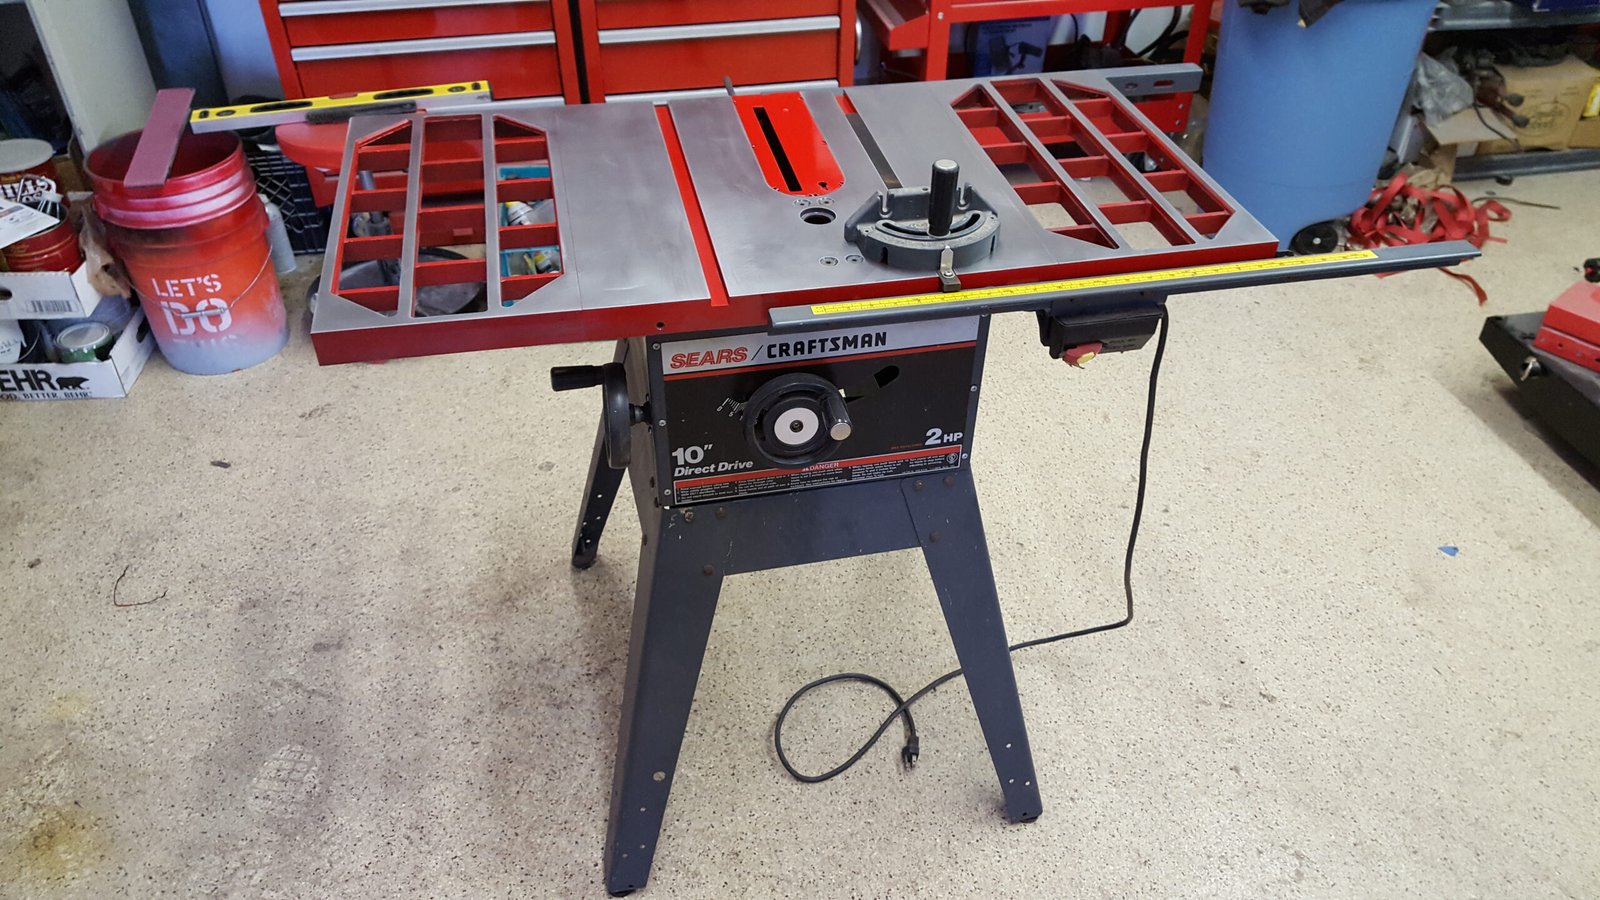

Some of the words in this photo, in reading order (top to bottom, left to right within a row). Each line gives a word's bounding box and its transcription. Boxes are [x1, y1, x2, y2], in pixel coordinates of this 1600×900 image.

[152, 273, 222, 297] LET'S
[160, 298, 232, 336] DO
[670, 347, 748, 369] SEARS
[767, 332, 887, 359] CRAFTSMAN
[0, 369, 58, 391] EHR
[925, 428, 943, 446] 2
[943, 432, 963, 443] HP
[674, 464, 715, 477] Direct
[717, 461, 754, 472] Drive
[810, 462, 839, 471] DANGER
